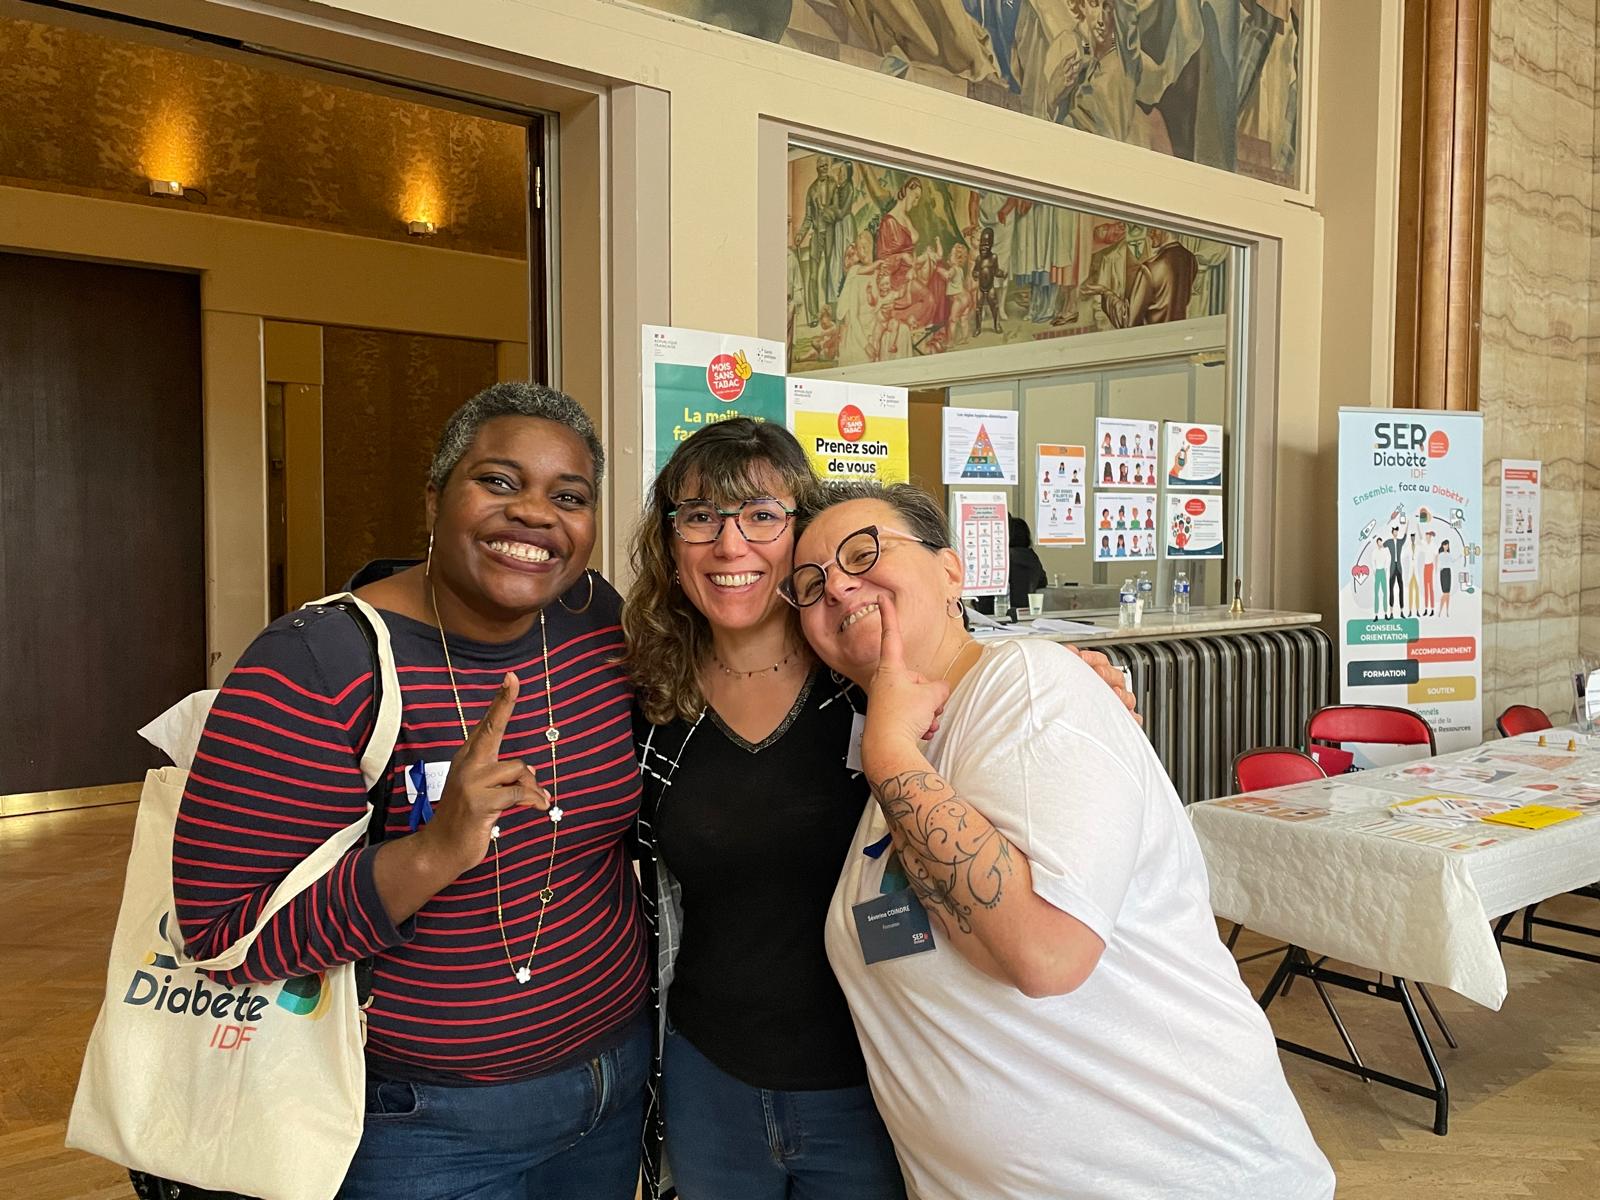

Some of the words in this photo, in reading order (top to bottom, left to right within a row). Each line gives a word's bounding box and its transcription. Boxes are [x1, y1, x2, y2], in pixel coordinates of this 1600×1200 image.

[711, 362, 731, 372] MOIS
[713, 370, 735, 380] SANS
[713, 379, 740, 389] TABAC
[684, 407, 702, 423] La
[1375, 422, 1427, 451] SER
[816, 438, 860, 454] Prenez
[862, 441, 888, 456] soin
[1374, 452, 1427, 467] Diabète
[828, 458, 844, 473] de
[847, 463, 876, 474] vous
[1410, 468, 1428, 479] IDF
[1353, 484, 1396, 505] Ensemble,
[1399, 482, 1417, 492] face
[1432, 485, 1464, 503] Diabète
[1366, 624, 1403, 632] CONSEILS,
[1360, 633, 1409, 641] ORIENTATION
[1411, 646, 1472, 655] ACCOMPAGNEMENT
[1363, 669, 1406, 678] FORMATION
[1427, 687, 1455, 695] SOUTIEN
[887, 905, 910, 916] COINDRE
[123, 969, 270, 1022] Diabète
[209, 1024, 257, 1051] IDF
